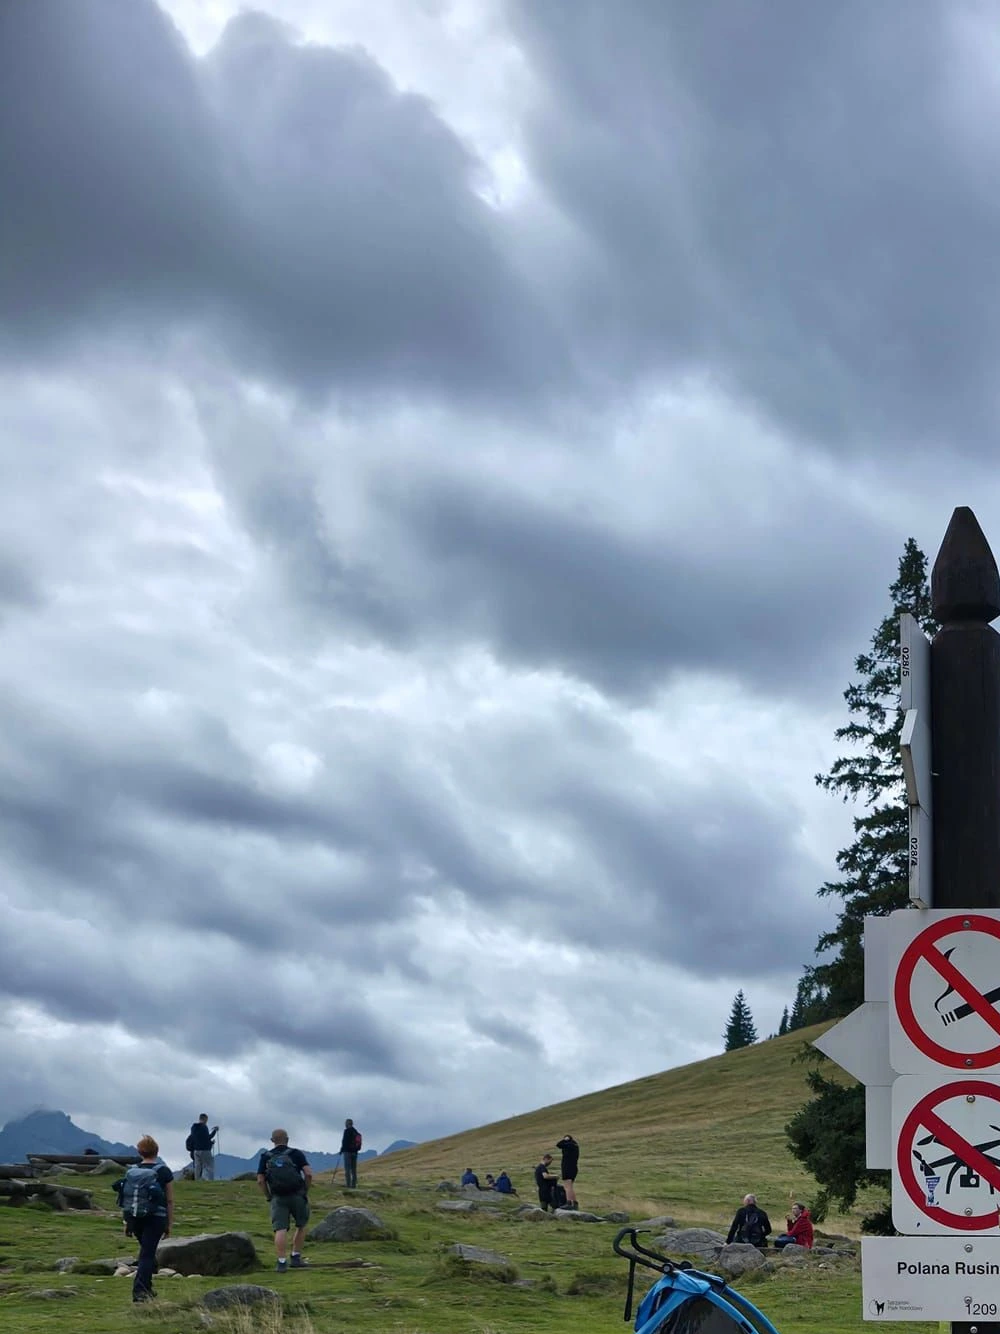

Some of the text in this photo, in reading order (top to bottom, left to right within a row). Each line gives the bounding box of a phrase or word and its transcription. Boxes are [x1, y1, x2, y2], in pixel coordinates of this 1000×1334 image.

[902, 647, 910, 677] 028/5
[897, 1261, 950, 1275] Polana
[965, 1303, 997, 1316] 1209
